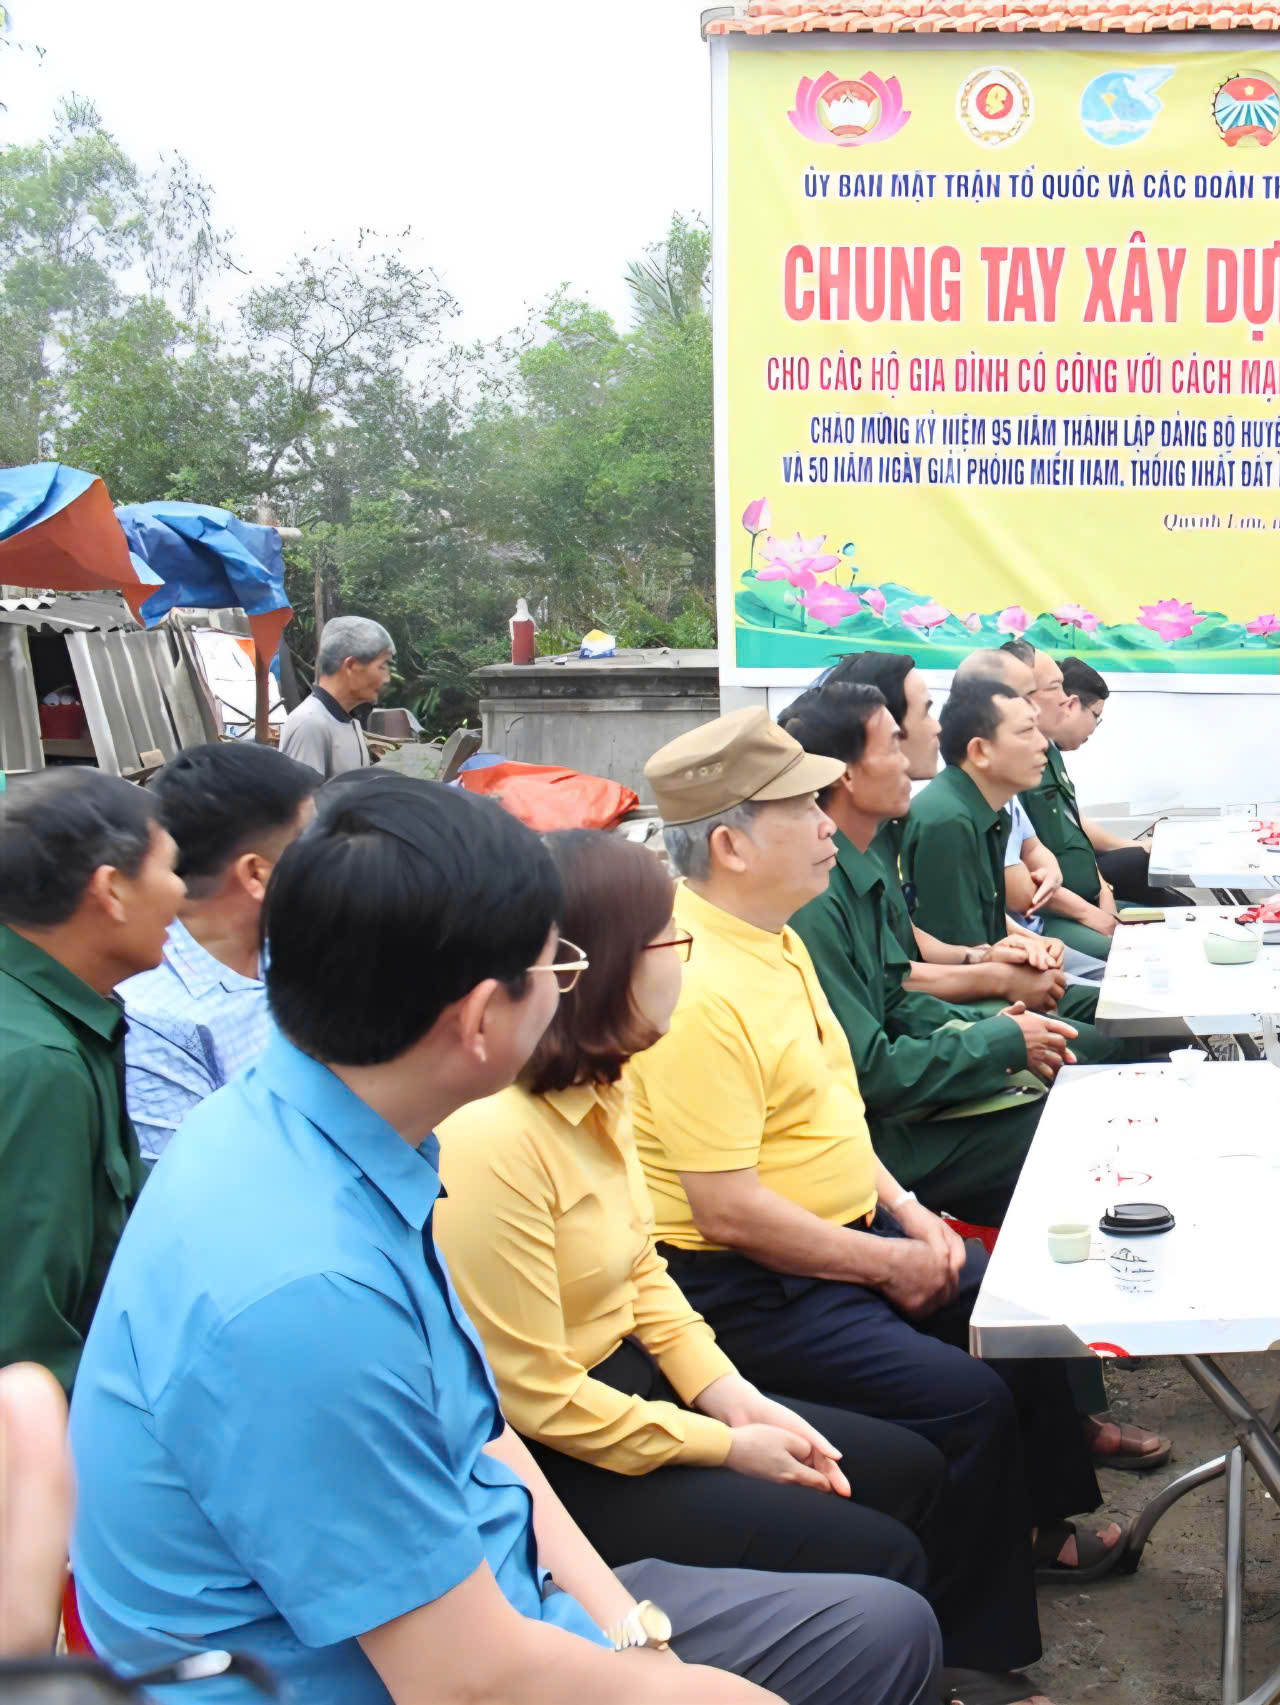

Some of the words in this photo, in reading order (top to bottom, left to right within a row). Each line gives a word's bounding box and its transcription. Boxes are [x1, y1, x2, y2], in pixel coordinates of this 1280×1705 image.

[838, 174, 883, 198] BAN
[891, 169, 937, 203] MẶT
[944, 169, 1001, 203] TRẬN
[1008, 164, 1036, 198] TỔ
[1042, 165, 1100, 200] QUỐC
[1108, 169, 1135, 198] VÀ
[1143, 169, 1187, 199] CÁC
[784, 244, 961, 322] CHUNG
[980, 247, 1066, 322] TAY
[1083, 230, 1187, 322] XÂY
[767, 356, 810, 391] CHO
[819, 349, 862, 391] CÁC
[871, 350, 900, 399] HỘ
[909, 357, 946, 392] GIA
[1018, 351, 1046, 393] CÓ
[1056, 351, 1117, 393] CÔNG
[1127, 352, 1161, 394] VỚI
[1171, 351, 1231, 394] CÁCH
[810, 411, 855, 444] CHÀO
[861, 412, 910, 444] MỪNG
[915, 409, 937, 445] KỶ
[942, 412, 986, 450] NIỆM
[992, 418, 1012, 446] 95
[1017, 414, 1056, 447] NĂM
[1063, 414, 1118, 447] THÀNH
[1124, 413, 1155, 452] LẬP
[1213, 414, 1235, 451] BỘ
[782, 450, 804, 483] VÀ
[808, 456, 828, 483] 50
[833, 451, 873, 483] NĂM
[878, 451, 923, 484] NGÀY
[927, 449, 961, 484] GIẢI
[967, 452, 1025, 486] PHÓNG
[1130, 451, 1186, 487] THỐNG
[1191, 451, 1236, 487] NHẤT
[1241, 451, 1273, 488] ĐẤT
